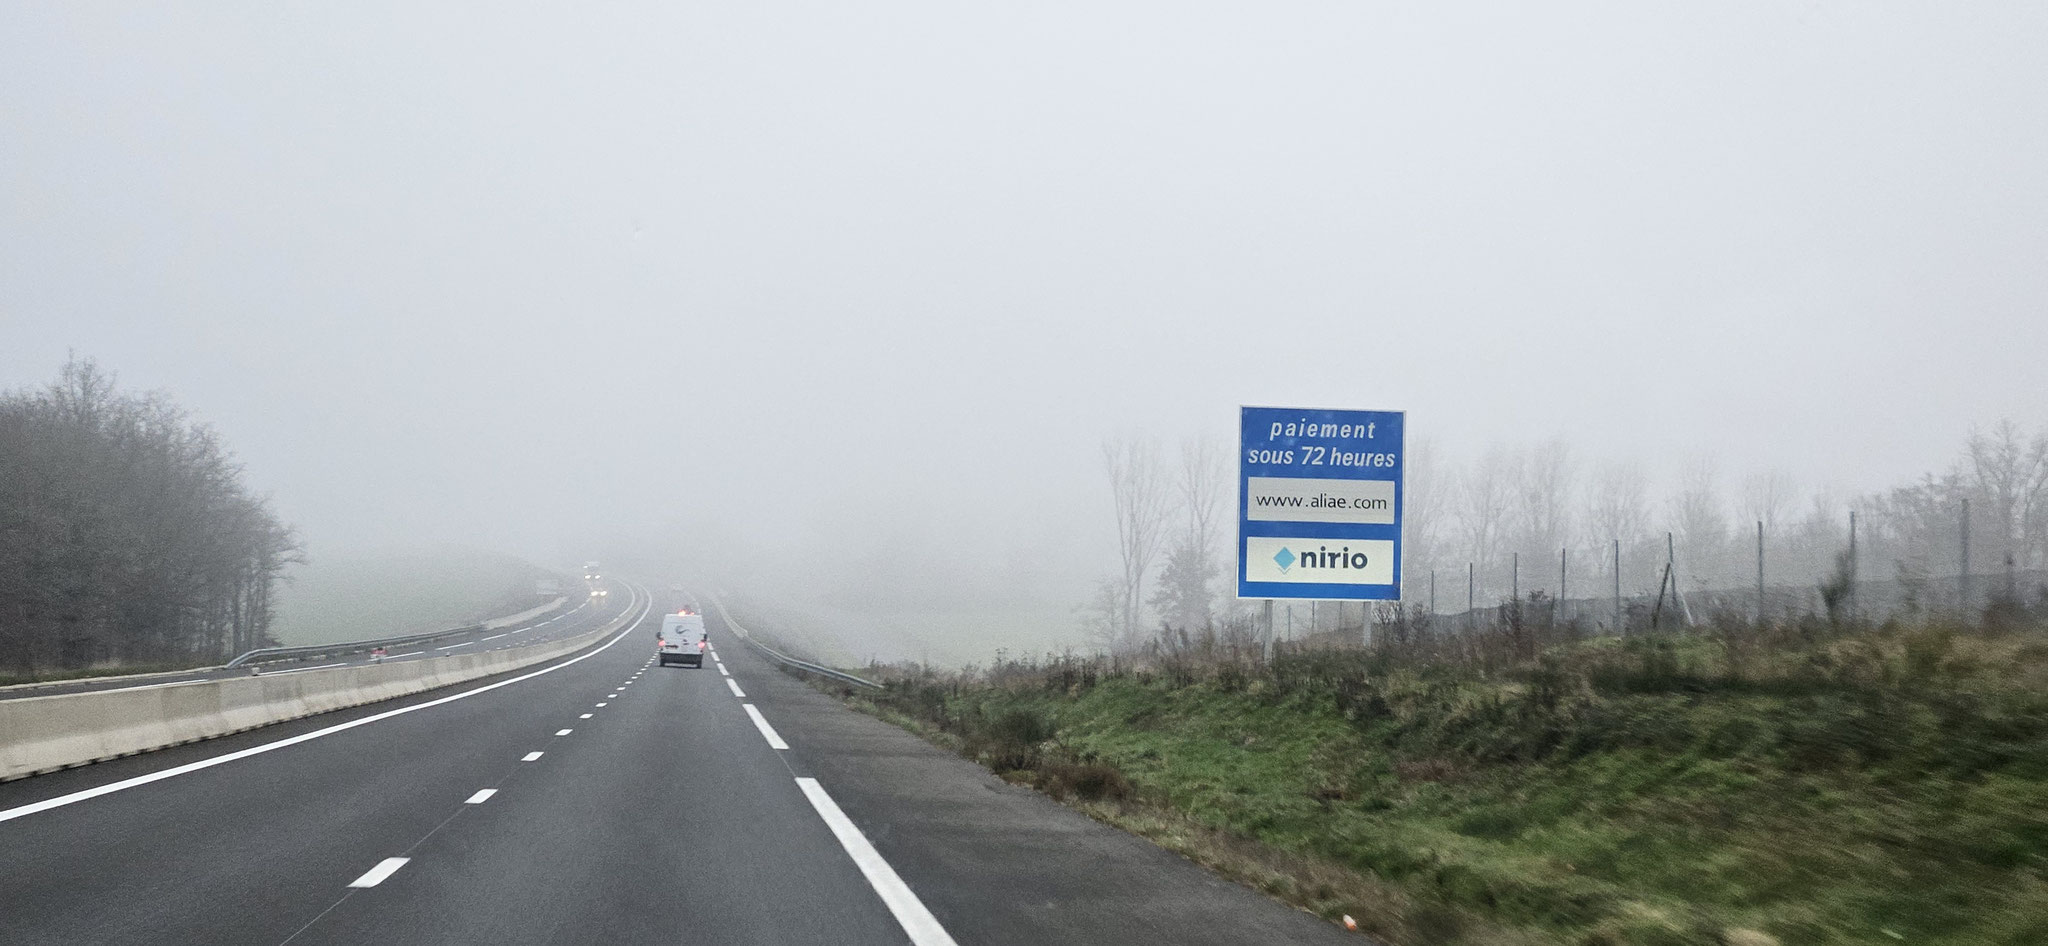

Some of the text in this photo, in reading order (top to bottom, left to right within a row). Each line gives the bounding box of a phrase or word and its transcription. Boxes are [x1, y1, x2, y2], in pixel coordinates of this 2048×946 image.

[1270, 418, 1375, 440] paiement
[1248, 446, 1395, 467] sous 72 heures
[1256, 493, 1387, 510] www.aliae.com
[1300, 546, 1368, 569] nirio
